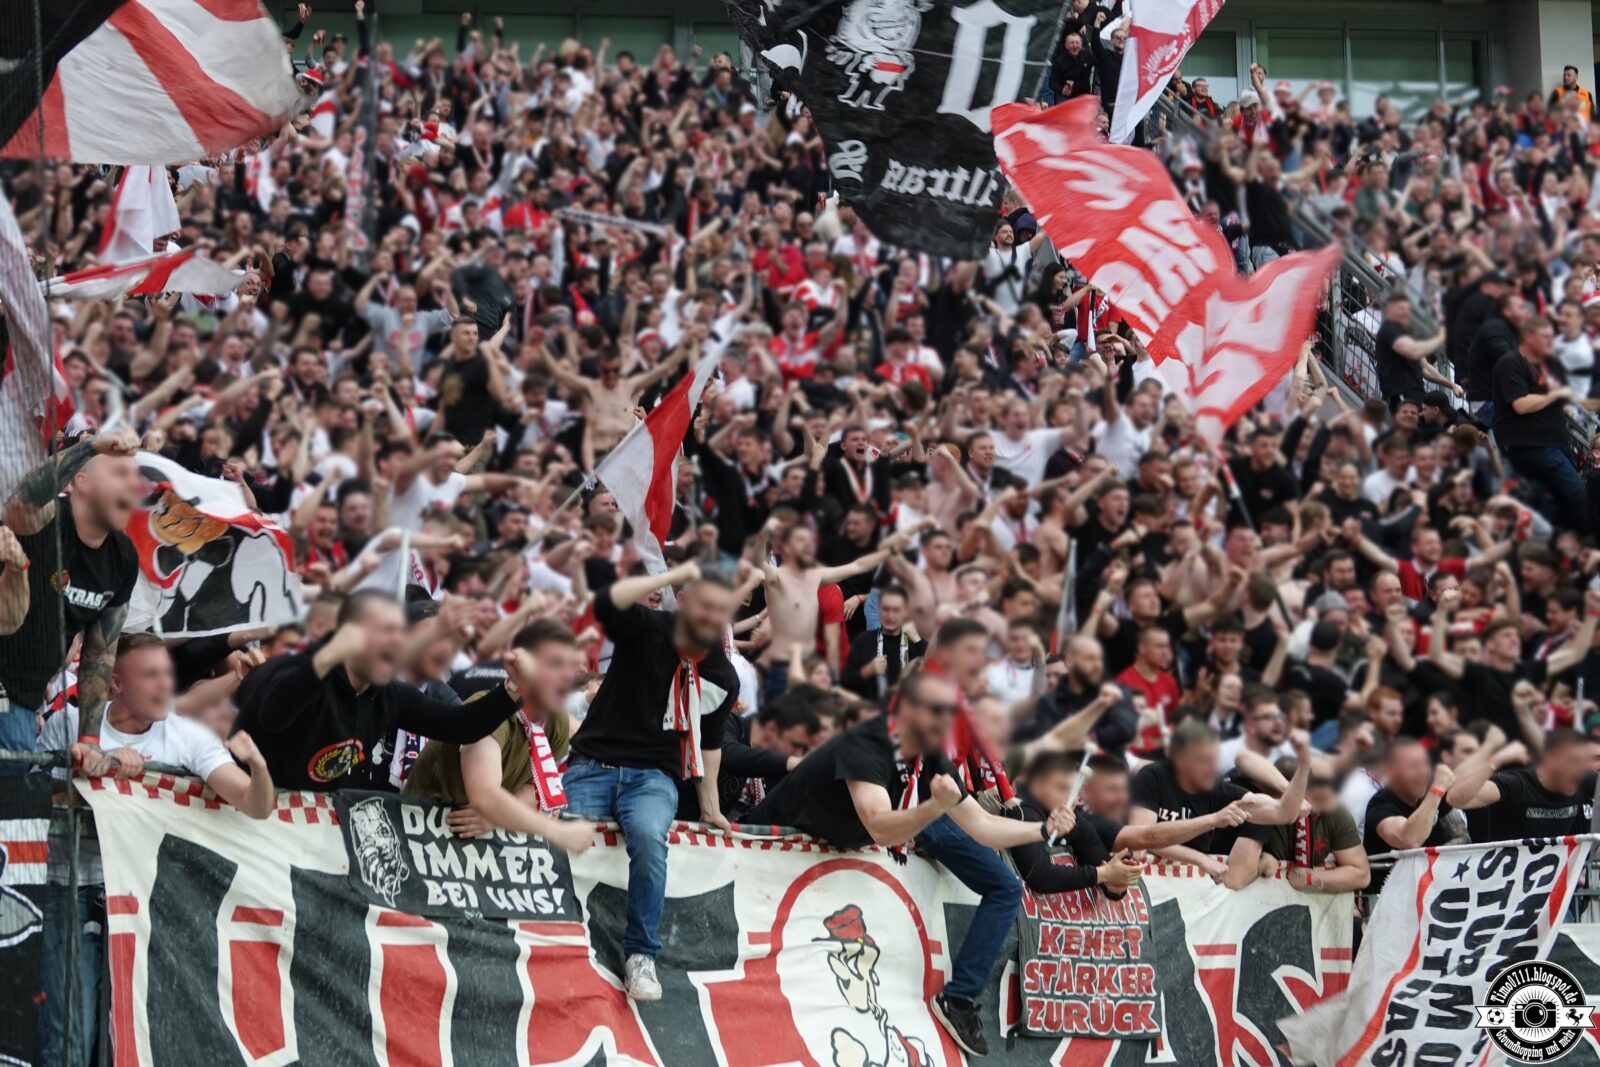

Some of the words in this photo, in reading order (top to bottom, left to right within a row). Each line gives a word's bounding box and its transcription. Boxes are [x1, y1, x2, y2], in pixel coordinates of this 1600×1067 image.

[407, 838, 560, 885] IMMER
[423, 879, 480, 908] BEI
[486, 886, 565, 915] UNS!
[1037, 921, 1143, 960] KEHRT
[1023, 957, 1158, 998] STÄRKER
[1025, 994, 1161, 1036] ZURÜCK
